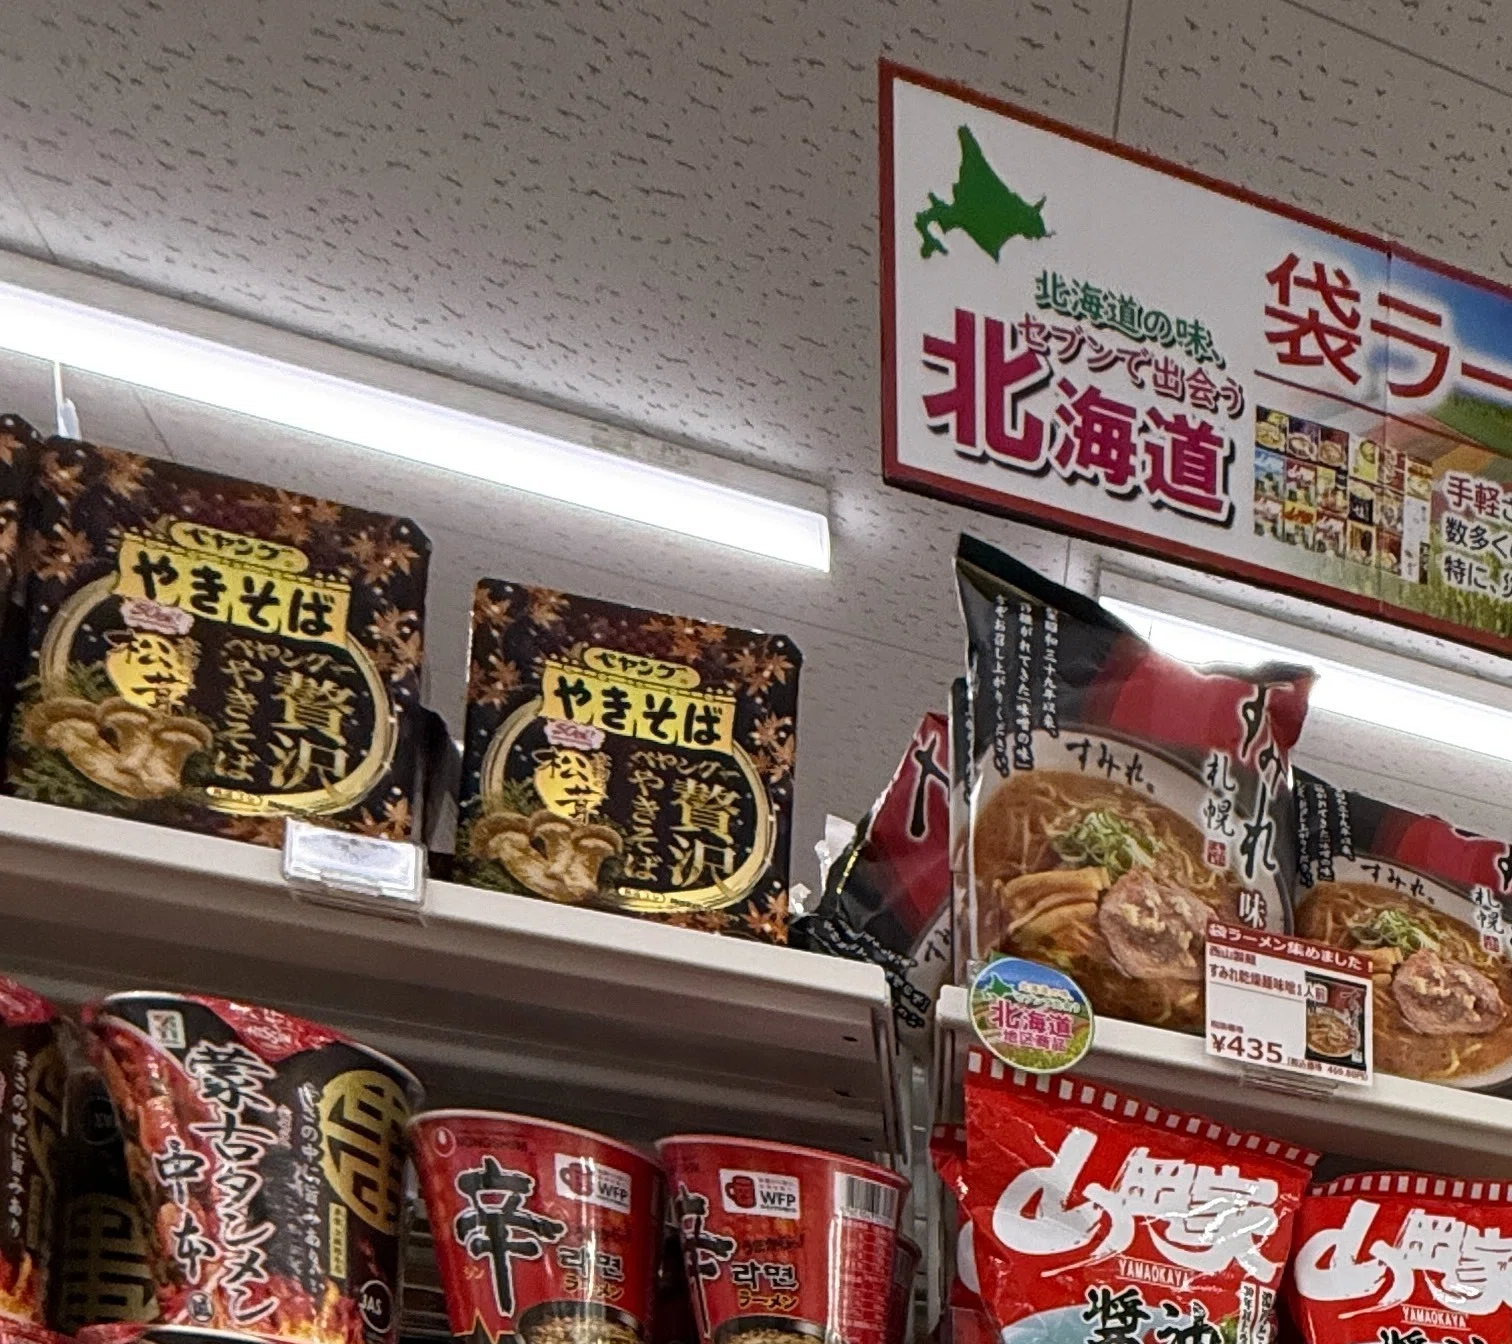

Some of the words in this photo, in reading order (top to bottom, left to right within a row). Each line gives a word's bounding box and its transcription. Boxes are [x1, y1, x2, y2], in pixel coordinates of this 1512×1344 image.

[1035, 270, 1227, 368] 北海道の味、
[1016, 313, 1245, 418] セブンで出会う
[922, 308, 1238, 524] 北海道
[131, 560, 338, 640] やきそば
[550, 674, 730, 749] やきそば
[1202, 754, 1240, 838] 札幌
[991, 1001, 1075, 1040] 北海道
[1210, 1031, 1284, 1066] ¥435
[187, 1040, 278, 1325] 蒙古タンメン
[598, 1184, 632, 1203] WFP
[759, 1190, 797, 1210] WFP
[454, 1154, 568, 1317] 辛
[731, 1261, 799, 1290] 라면
[737, 1287, 799, 1311] ラーメン
[1118, 1259, 1193, 1285] YAMAOKAYA
[1402, 1304, 1470, 1330] YAMAOKAYA
